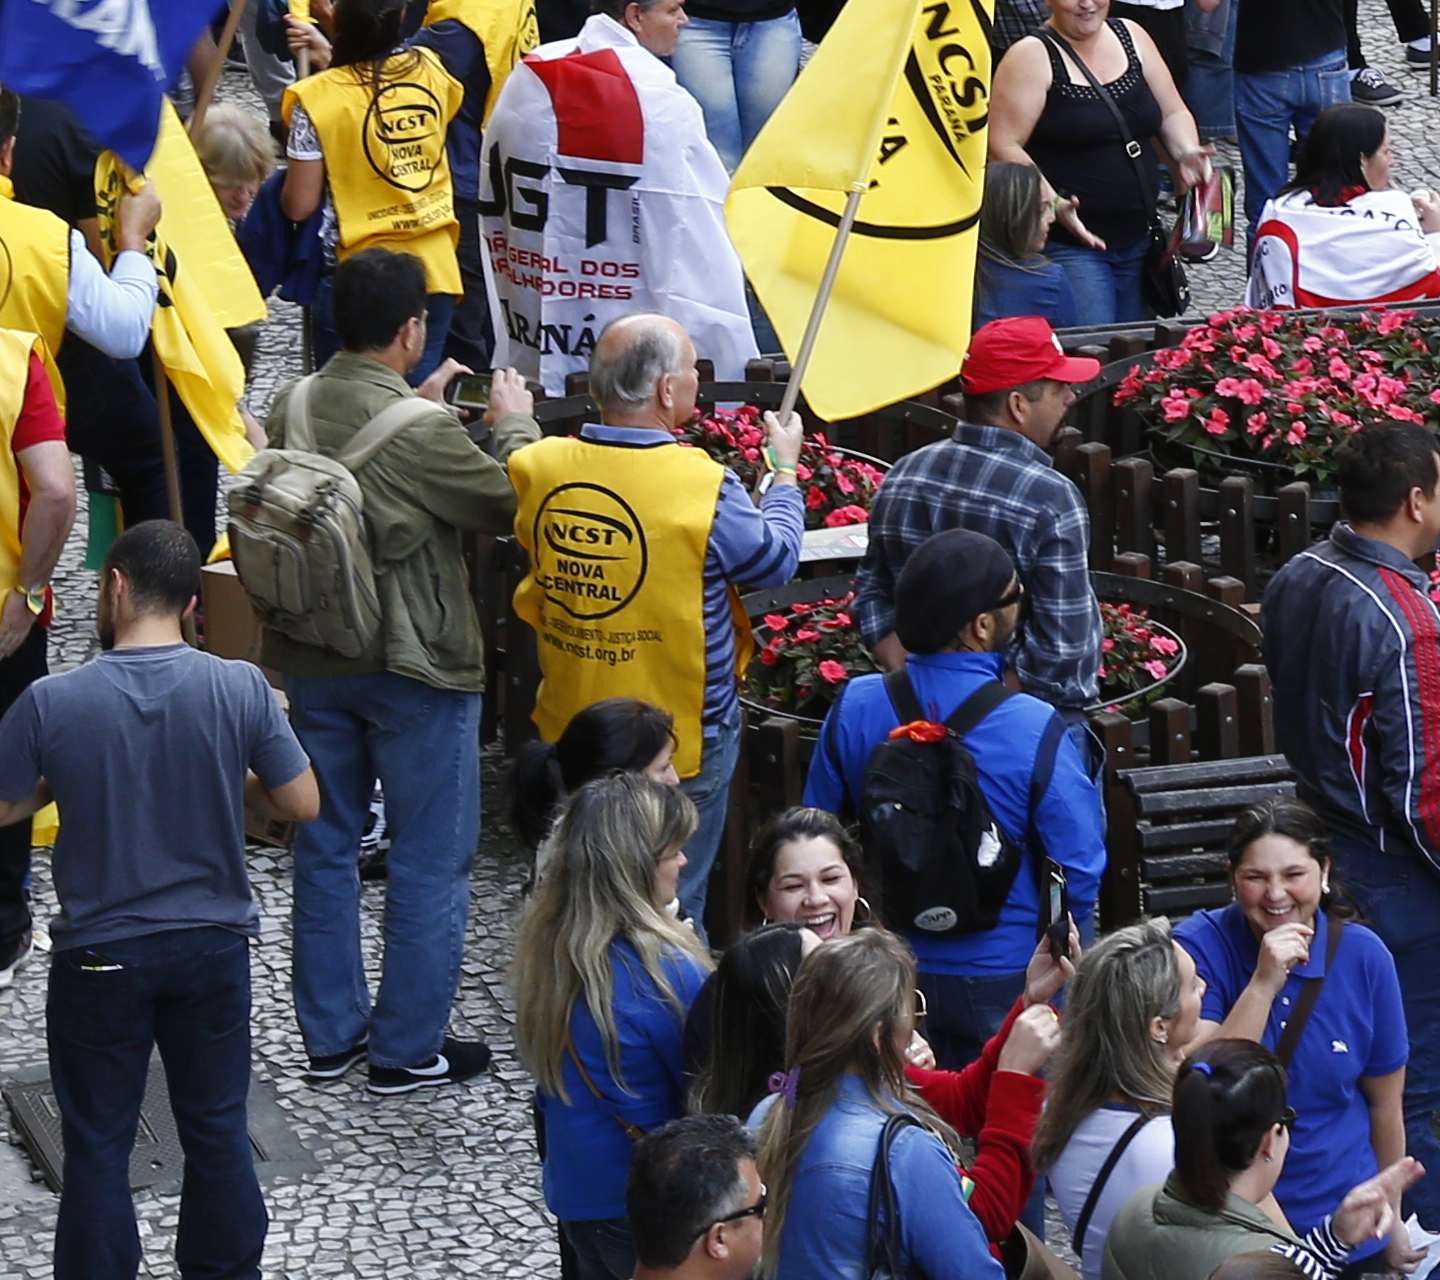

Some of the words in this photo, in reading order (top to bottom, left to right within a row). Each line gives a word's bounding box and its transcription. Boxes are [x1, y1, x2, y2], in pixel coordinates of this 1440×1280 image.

[380, 112, 428, 136] NCST
[393, 143, 423, 165] NOVA
[388, 156, 431, 177] CENTRAL
[579, 260, 640, 280] DOS
[546, 520, 616, 549] NCST
[557, 561, 606, 581] NOVA
[541, 577, 623, 604] CENTRAL
